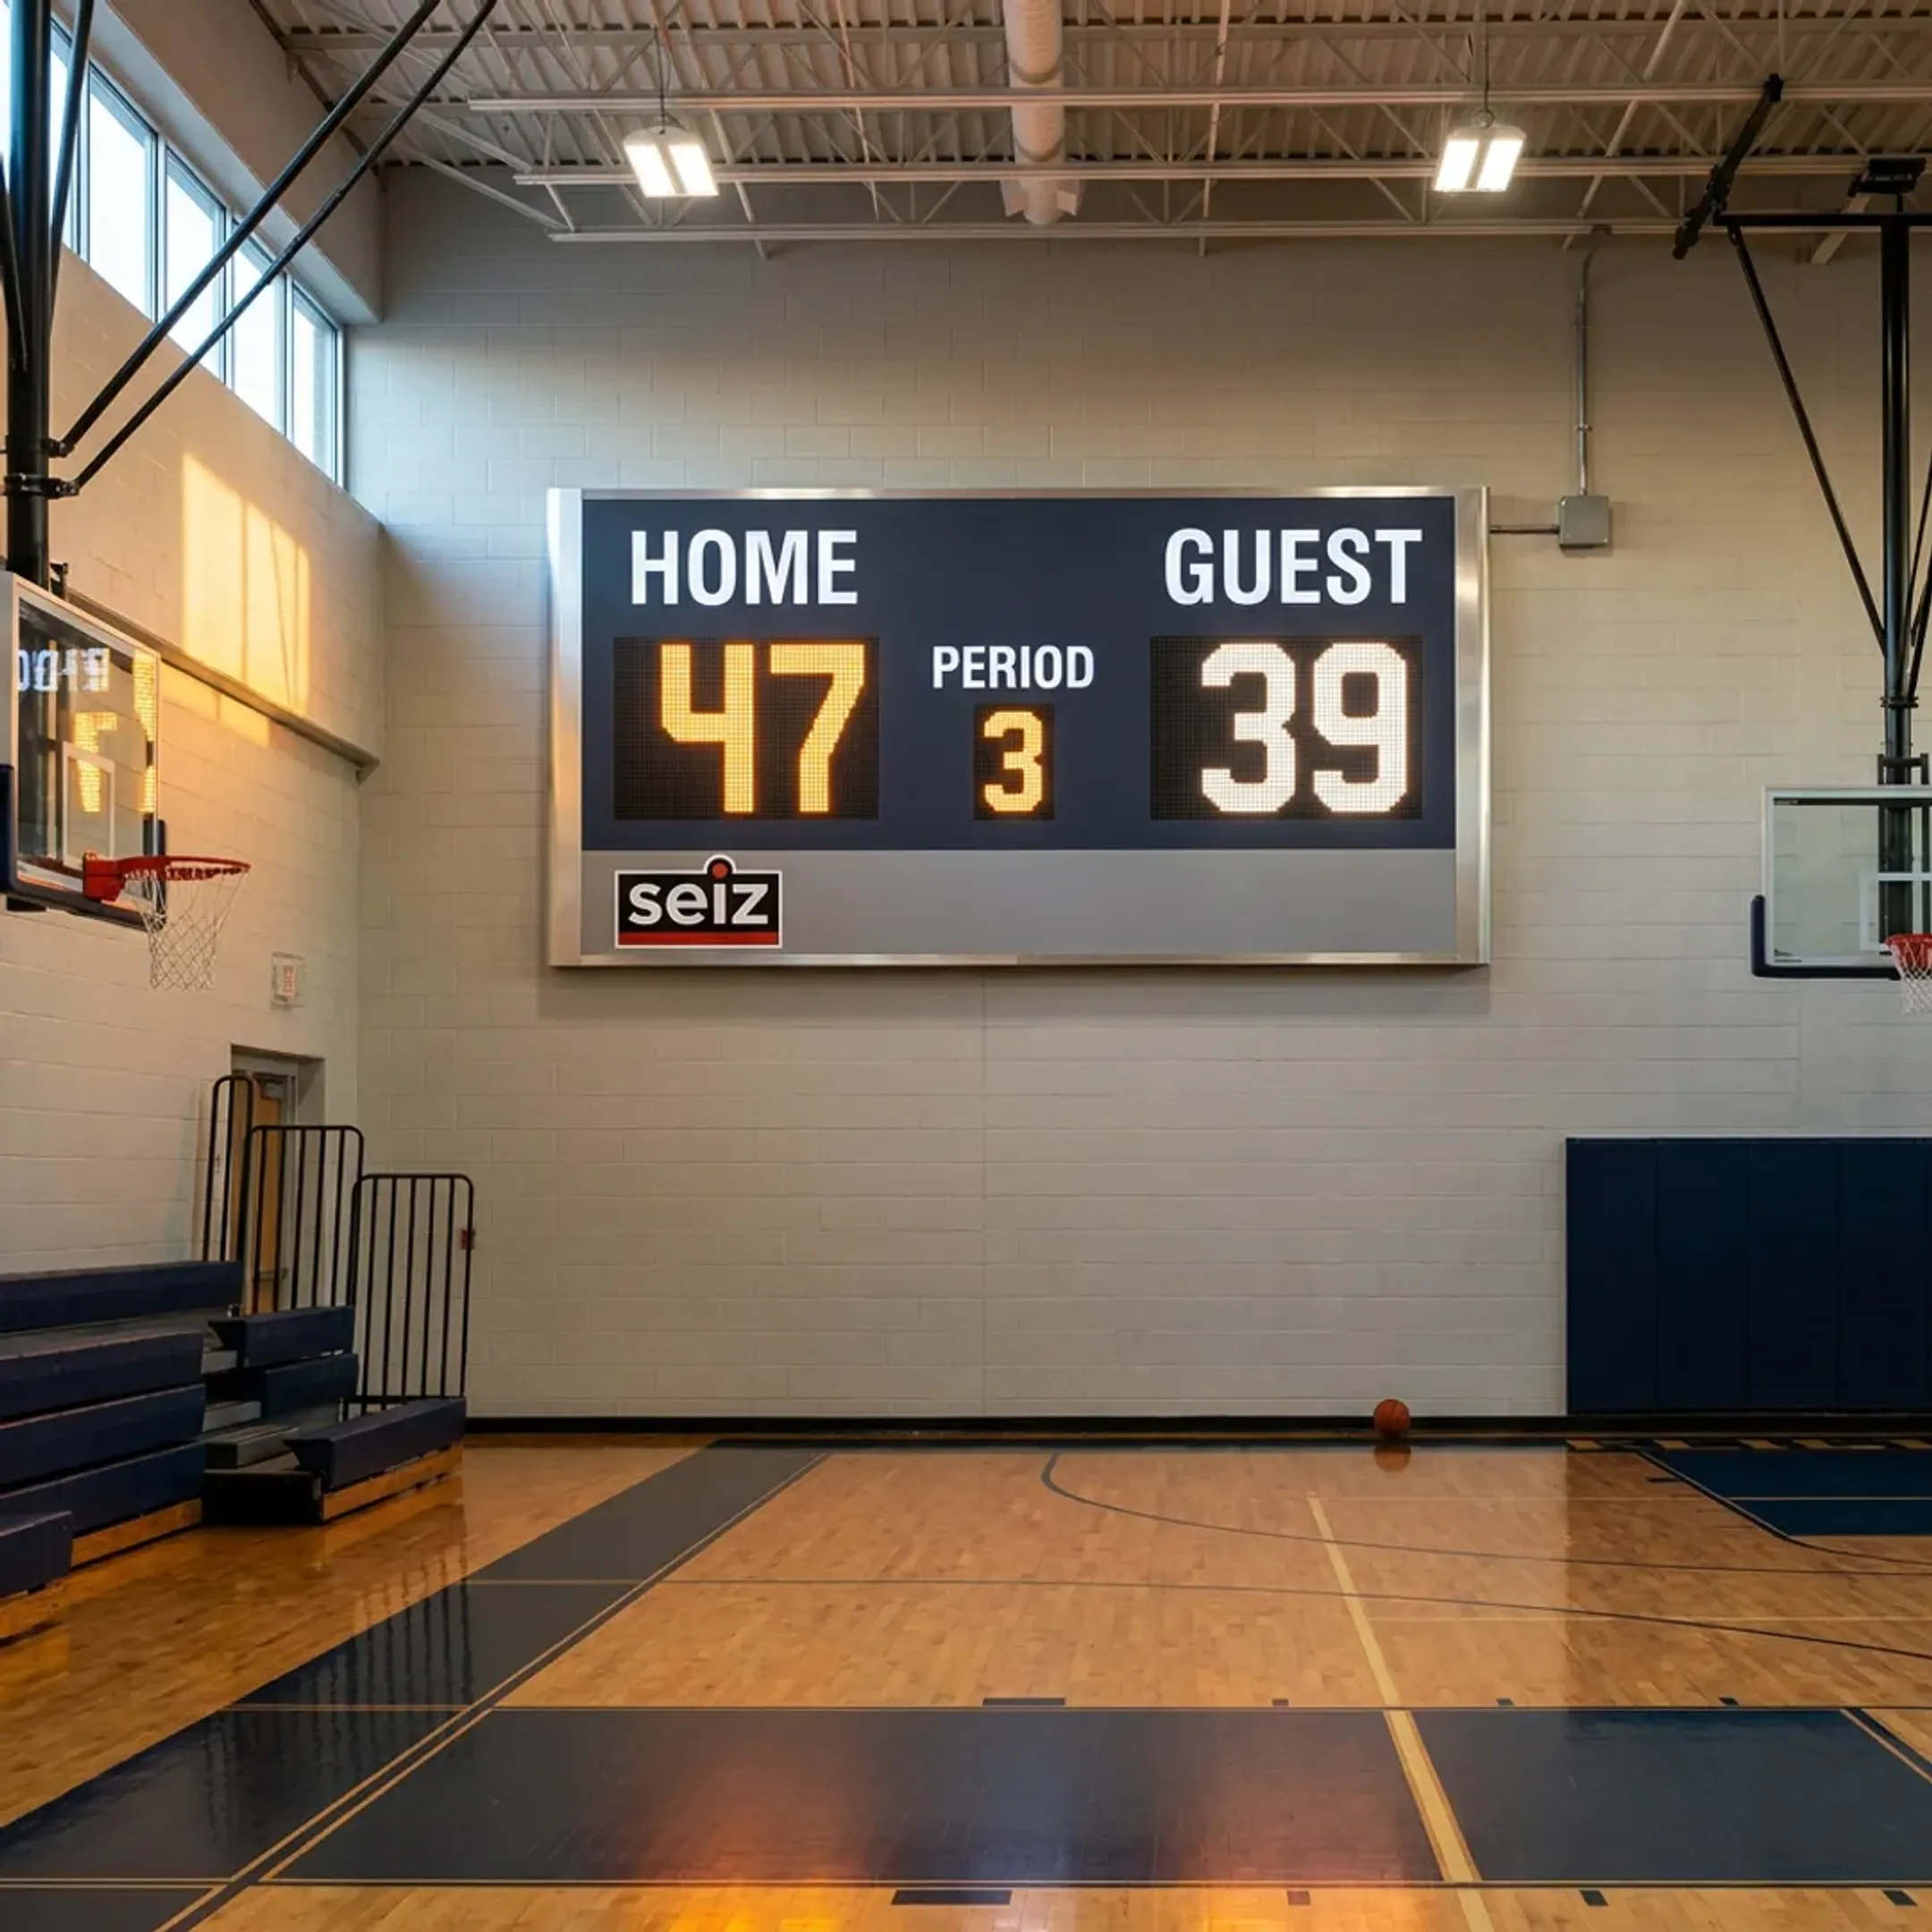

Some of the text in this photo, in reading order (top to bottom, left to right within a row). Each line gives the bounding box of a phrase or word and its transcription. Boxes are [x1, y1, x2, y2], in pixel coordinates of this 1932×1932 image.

[631, 529, 858, 606] HOME
[1165, 528, 1422, 606] GUEST
[933, 644, 1095, 690] PERIOD
[660, 643, 866, 813] 47
[984, 711, 1043, 812] 3
[1201, 642, 1408, 813] 39
[628, 861, 769, 926] seiz
